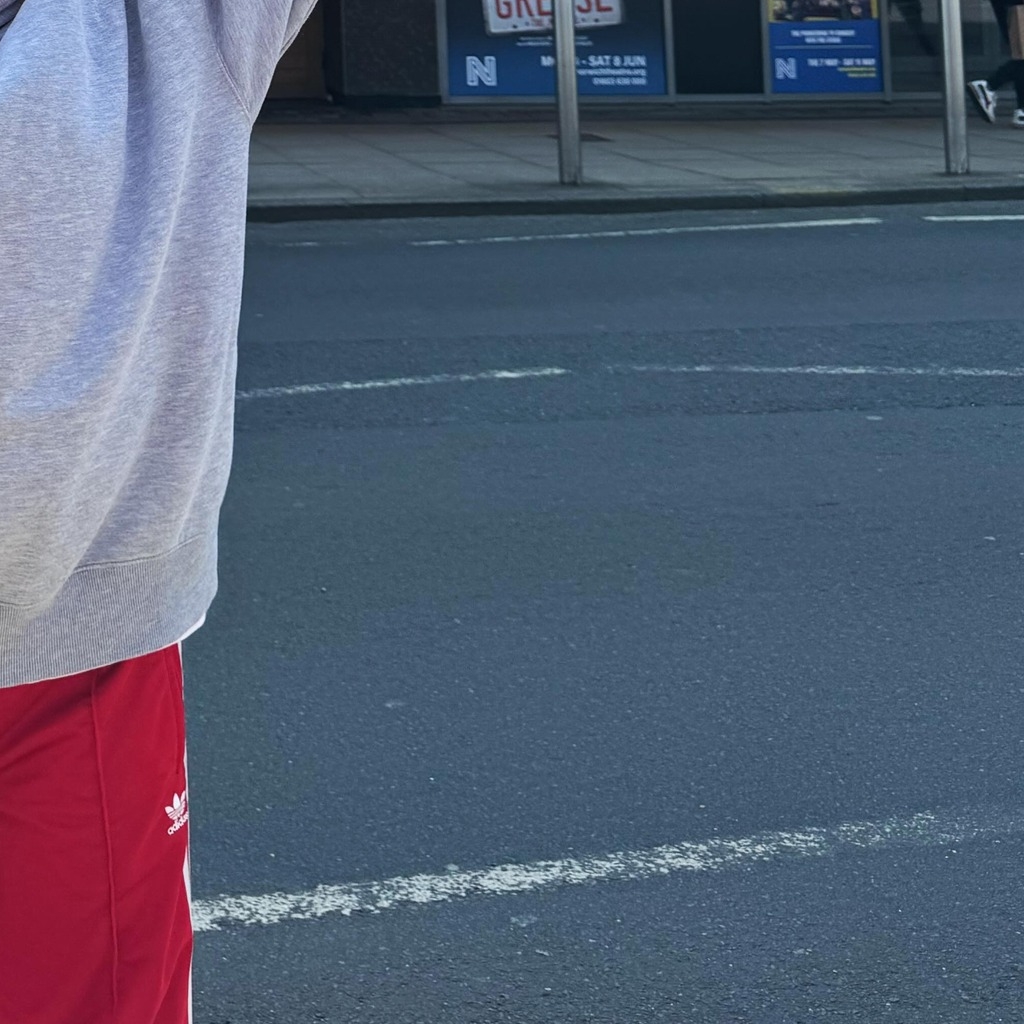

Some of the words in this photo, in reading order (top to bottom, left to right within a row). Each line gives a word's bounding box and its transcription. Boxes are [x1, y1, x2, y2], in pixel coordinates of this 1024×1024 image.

[466, 56, 497, 86] N
[588, 55, 611, 67] SAT
[623, 55, 646, 67] JUN
[775, 57, 797, 80] N
